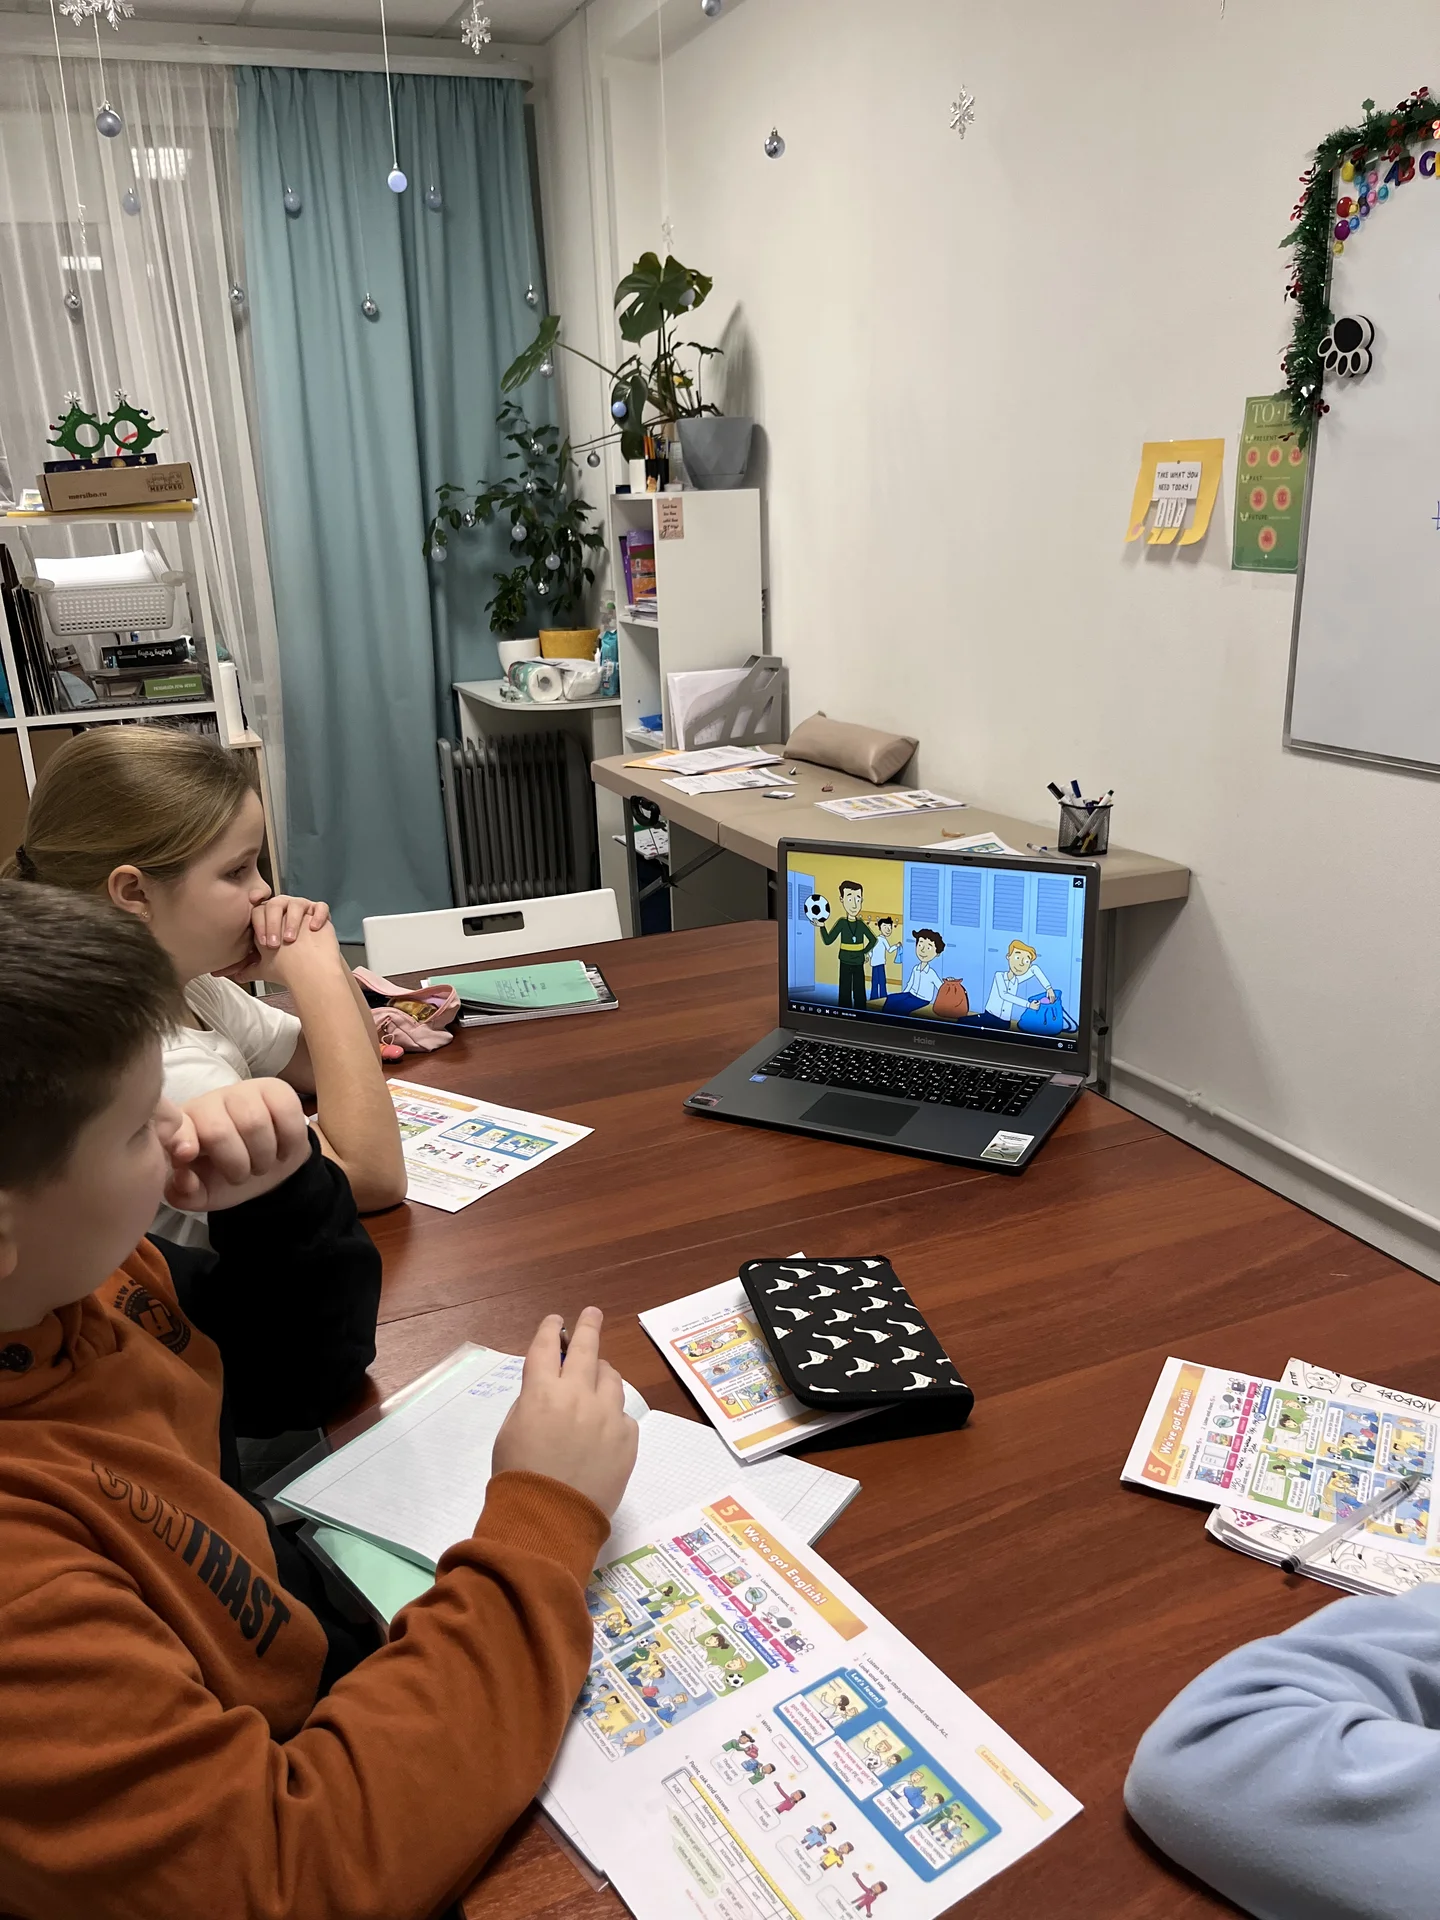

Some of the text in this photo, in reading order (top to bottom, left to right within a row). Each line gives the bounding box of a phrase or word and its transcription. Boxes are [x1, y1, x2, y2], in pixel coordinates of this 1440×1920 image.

[68, 491, 108, 500] mersibo.ru
[912, 1035, 936, 1045] Haier
[1146, 1386, 1195, 1477] 5 We've got English!
[720, 1538, 731, 1549] and
[721, 1503, 827, 1608] 5 We've got English!
[759, 1577, 772, 1590] Listen
[769, 1587, 780, 1597] and
[857, 1661, 870, 1674] Look
[867, 1670, 879, 1683] and
[849, 1670, 883, 1704] Let's learn!
[865, 1656, 881, 1671] Listen
[882, 1672, 893, 1683] the
[889, 1680, 903, 1694] story
[900, 1690, 916, 1706] again
[913, 1702, 925, 1714] and
[921, 1711, 940, 1731] repeat.
[937, 1726, 950, 1739] Act.
[789, 1702, 800, 1713] got
[799, 1699, 826, 1731] What have we
[792, 1717, 802, 1728] got
[833, 1738, 847, 1753] When
[844, 1751, 857, 1764] have
[853, 1762, 863, 1771] we
[859, 1769, 870, 1779] got
[843, 1761, 854, 1773] got
[850, 1770, 859, 1778] PE
[856, 1776, 864, 1785] on
[688, 1759, 731, 1814] Point, ask and answer.
[883, 1805, 892, 1814] PE
[885, 1795, 907, 1819] These are
[692, 1811, 736, 1867] maths science
[700, 1803, 746, 1863] Monday Tuesday
[908, 1833, 921, 1847] their
[923, 1837, 934, 1849] can
[931, 1846, 945, 1861] wear
[751, 1890, 760, 1900] art
[753, 1873, 779, 1904] Wednesday
